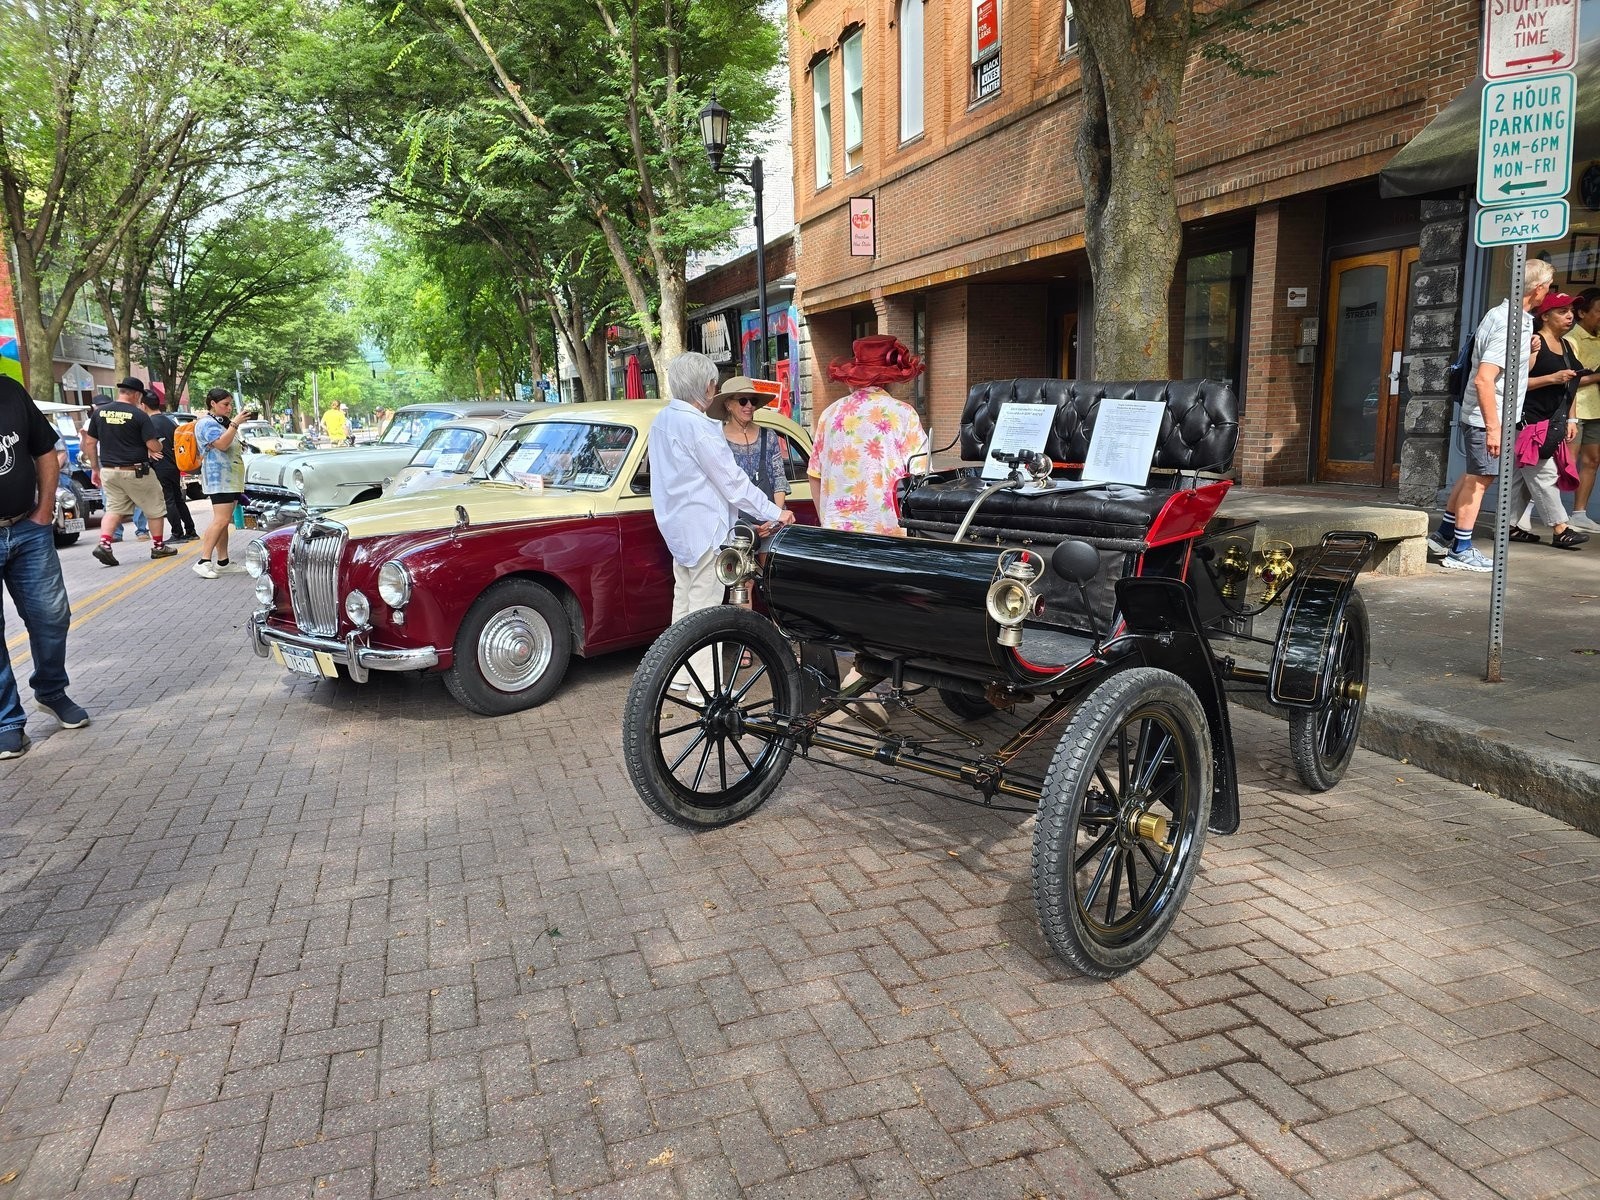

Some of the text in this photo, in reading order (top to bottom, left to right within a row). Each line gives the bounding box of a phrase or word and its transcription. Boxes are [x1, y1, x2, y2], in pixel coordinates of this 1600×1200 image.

[979, 23, 987, 31] FOR
[1516, 11, 1548, 29] ANY
[979, 27, 991, 40] LEASE
[1514, 29, 1549, 48] TIME
[983, 57, 998, 73] BLACK
[983, 69, 998, 83] LIVES
[1495, 86, 1561, 113] 2 HOUR
[1489, 110, 1565, 138] PARKING
[1493, 136, 1559, 158] 9AM-6PM
[1493, 157, 1556, 179] MON-FRI
[1495, 210, 1549, 224] PAY TO
[1501, 224, 1540, 236] PARK
[1345, 309, 1377, 320] STREAM
[2, 431, 19, 448] Club
